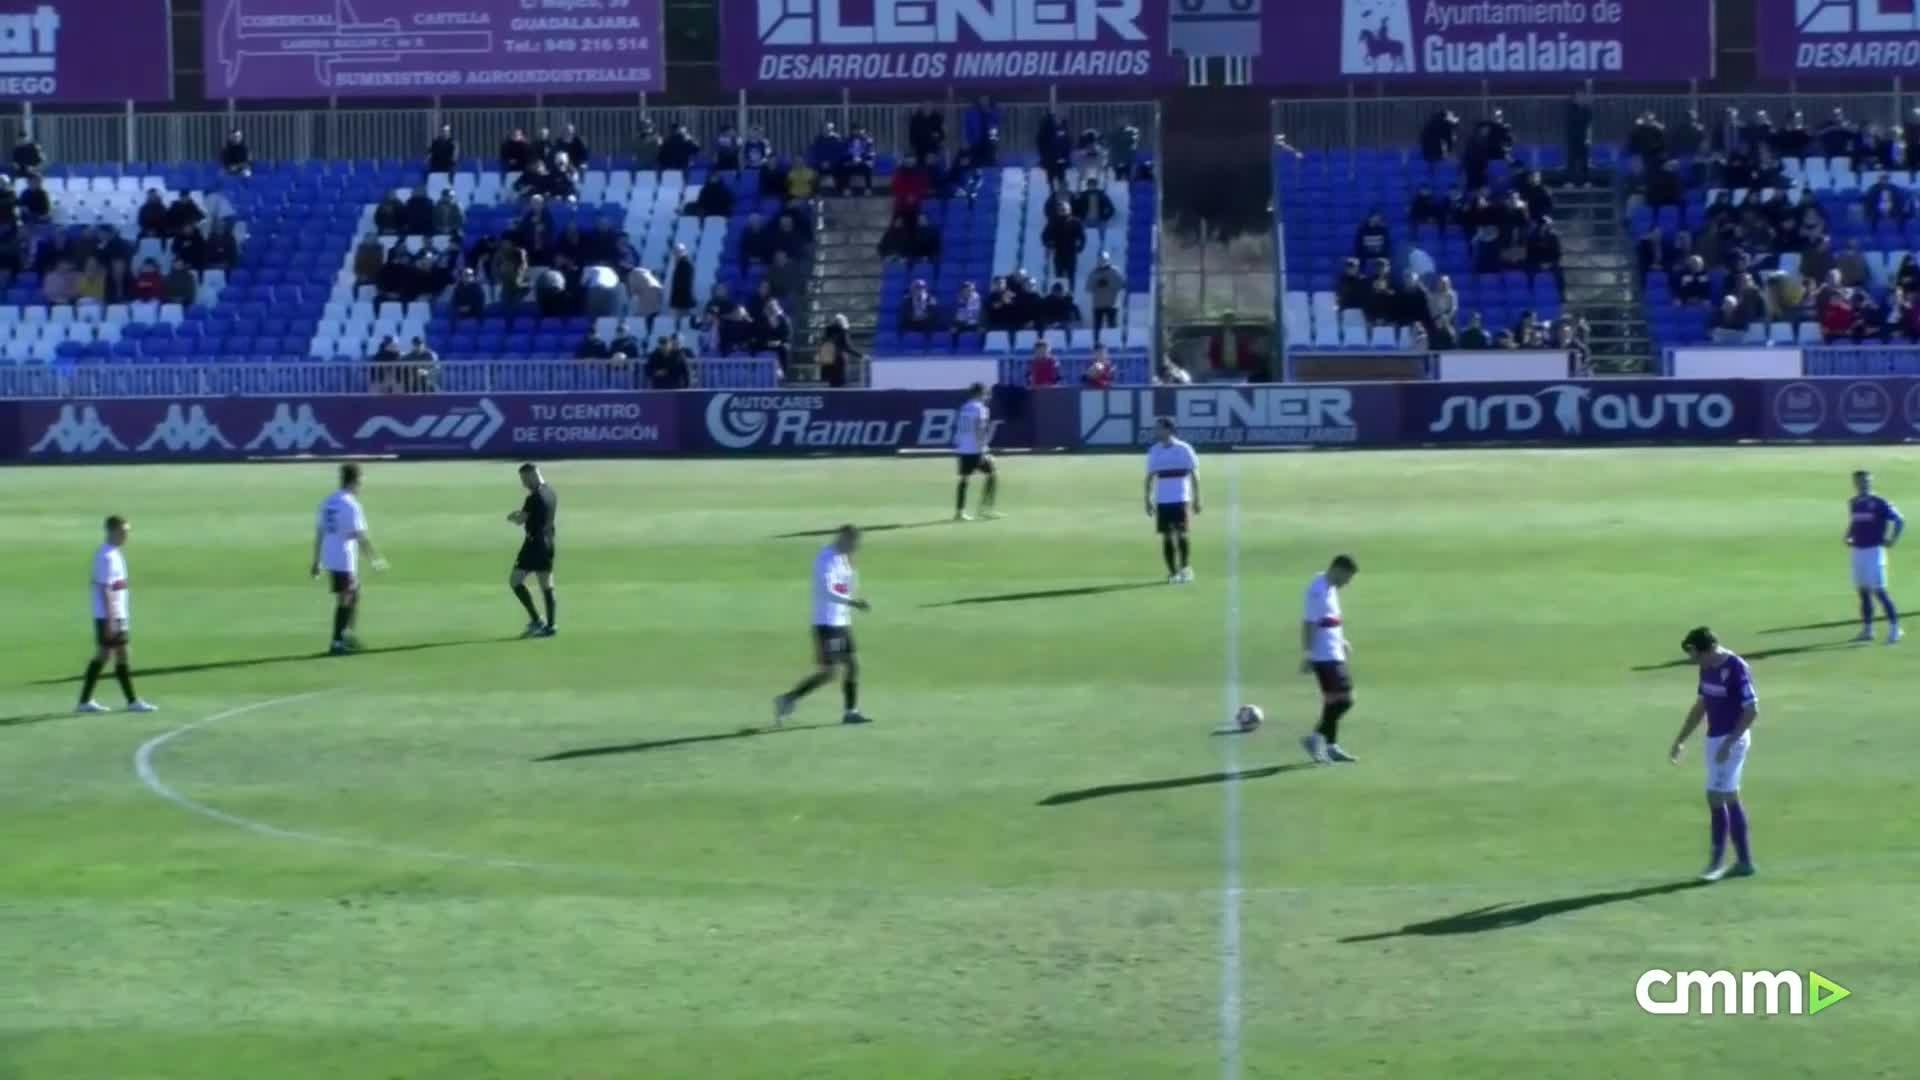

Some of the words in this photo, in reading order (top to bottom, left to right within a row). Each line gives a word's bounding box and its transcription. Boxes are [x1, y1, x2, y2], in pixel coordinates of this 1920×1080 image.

[413, 13, 490, 25] CASTILLA
[511, 16, 640, 31] GUADALAJARA
[1424, 0, 1585, 31] Ayuntamiento
[1591, 0, 1621, 24] de
[580, 38, 613, 50] 216
[616, 37, 649, 50] 514
[1424, 32, 1623, 72] Guadalajara
[758, 53, 946, 80] DESARROLLOS
[954, 50, 1150, 77] INMOBILIARIOS
[335, 71, 462, 86] SUMINISTROS
[466, 67, 651, 83] AGROINDUSTRIALES
[531, 404, 556, 420] TU
[560, 403, 640, 419] CENTRO
[728, 396, 824, 409] AUTOCARES
[1140, 388, 1354, 427] LENER
[513, 428, 538, 442] DE
[543, 424, 658, 442] FORMACIÓN
